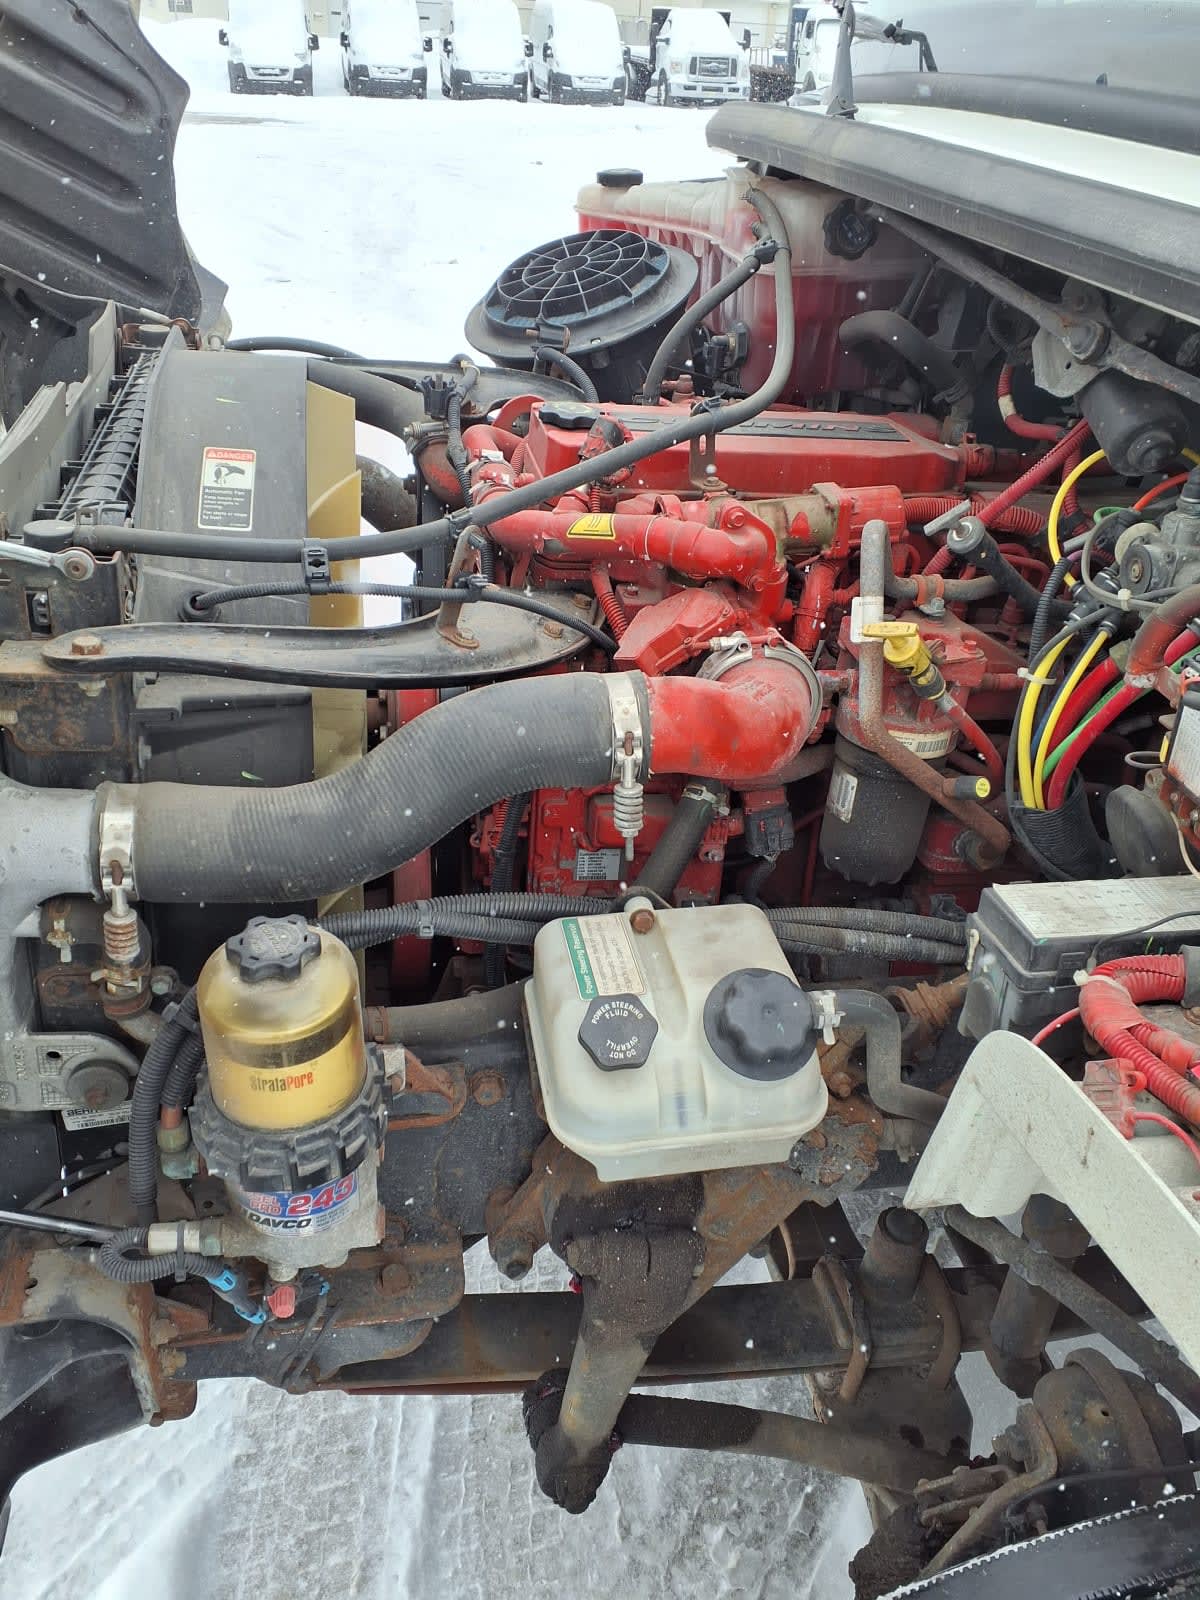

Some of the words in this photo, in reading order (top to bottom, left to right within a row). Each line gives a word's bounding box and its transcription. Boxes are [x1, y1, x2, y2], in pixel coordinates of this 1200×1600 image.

[216, 451, 253, 460] DANGER
[591, 1003, 611, 1025] POWER
[611, 1001, 644, 1020] STEERING
[604, 1009, 629, 1020] FLUID
[606, 1035, 639, 1052] OVERFILL
[609, 1051, 625, 1059] NOT
[626, 1048, 637, 1058] DO
[286, 1173, 355, 1217] 243
[248, 1212, 312, 1229] DAVCO
